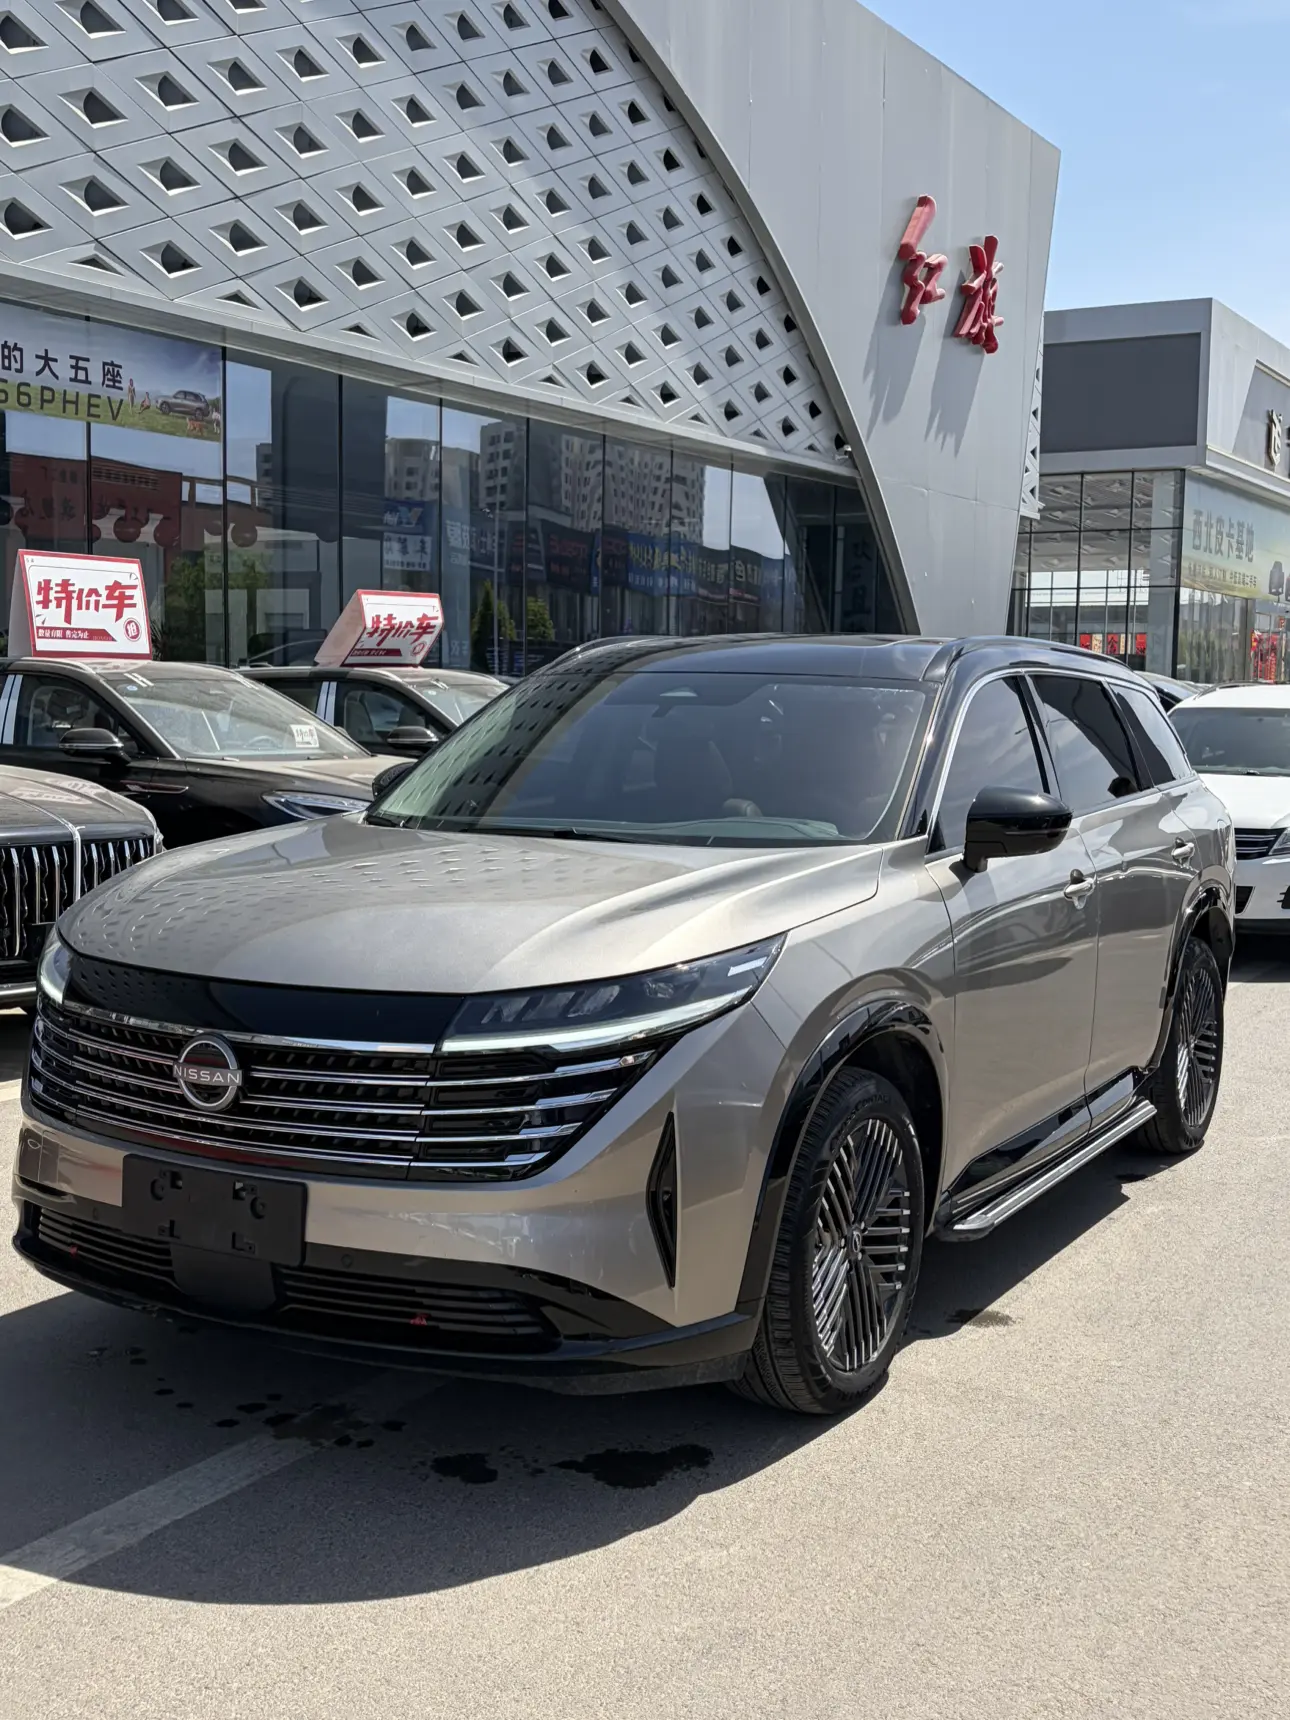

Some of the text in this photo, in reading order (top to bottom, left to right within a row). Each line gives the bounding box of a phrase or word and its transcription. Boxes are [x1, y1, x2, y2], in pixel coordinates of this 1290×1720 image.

[1, 340, 124, 391] 的大五座
[1192, 509, 1255, 563] 西北皮卡基地
[35, 579, 139, 626] 特价车
[366, 613, 439, 647] 特价车
[174, 1064, 240, 1083] NISSAN
